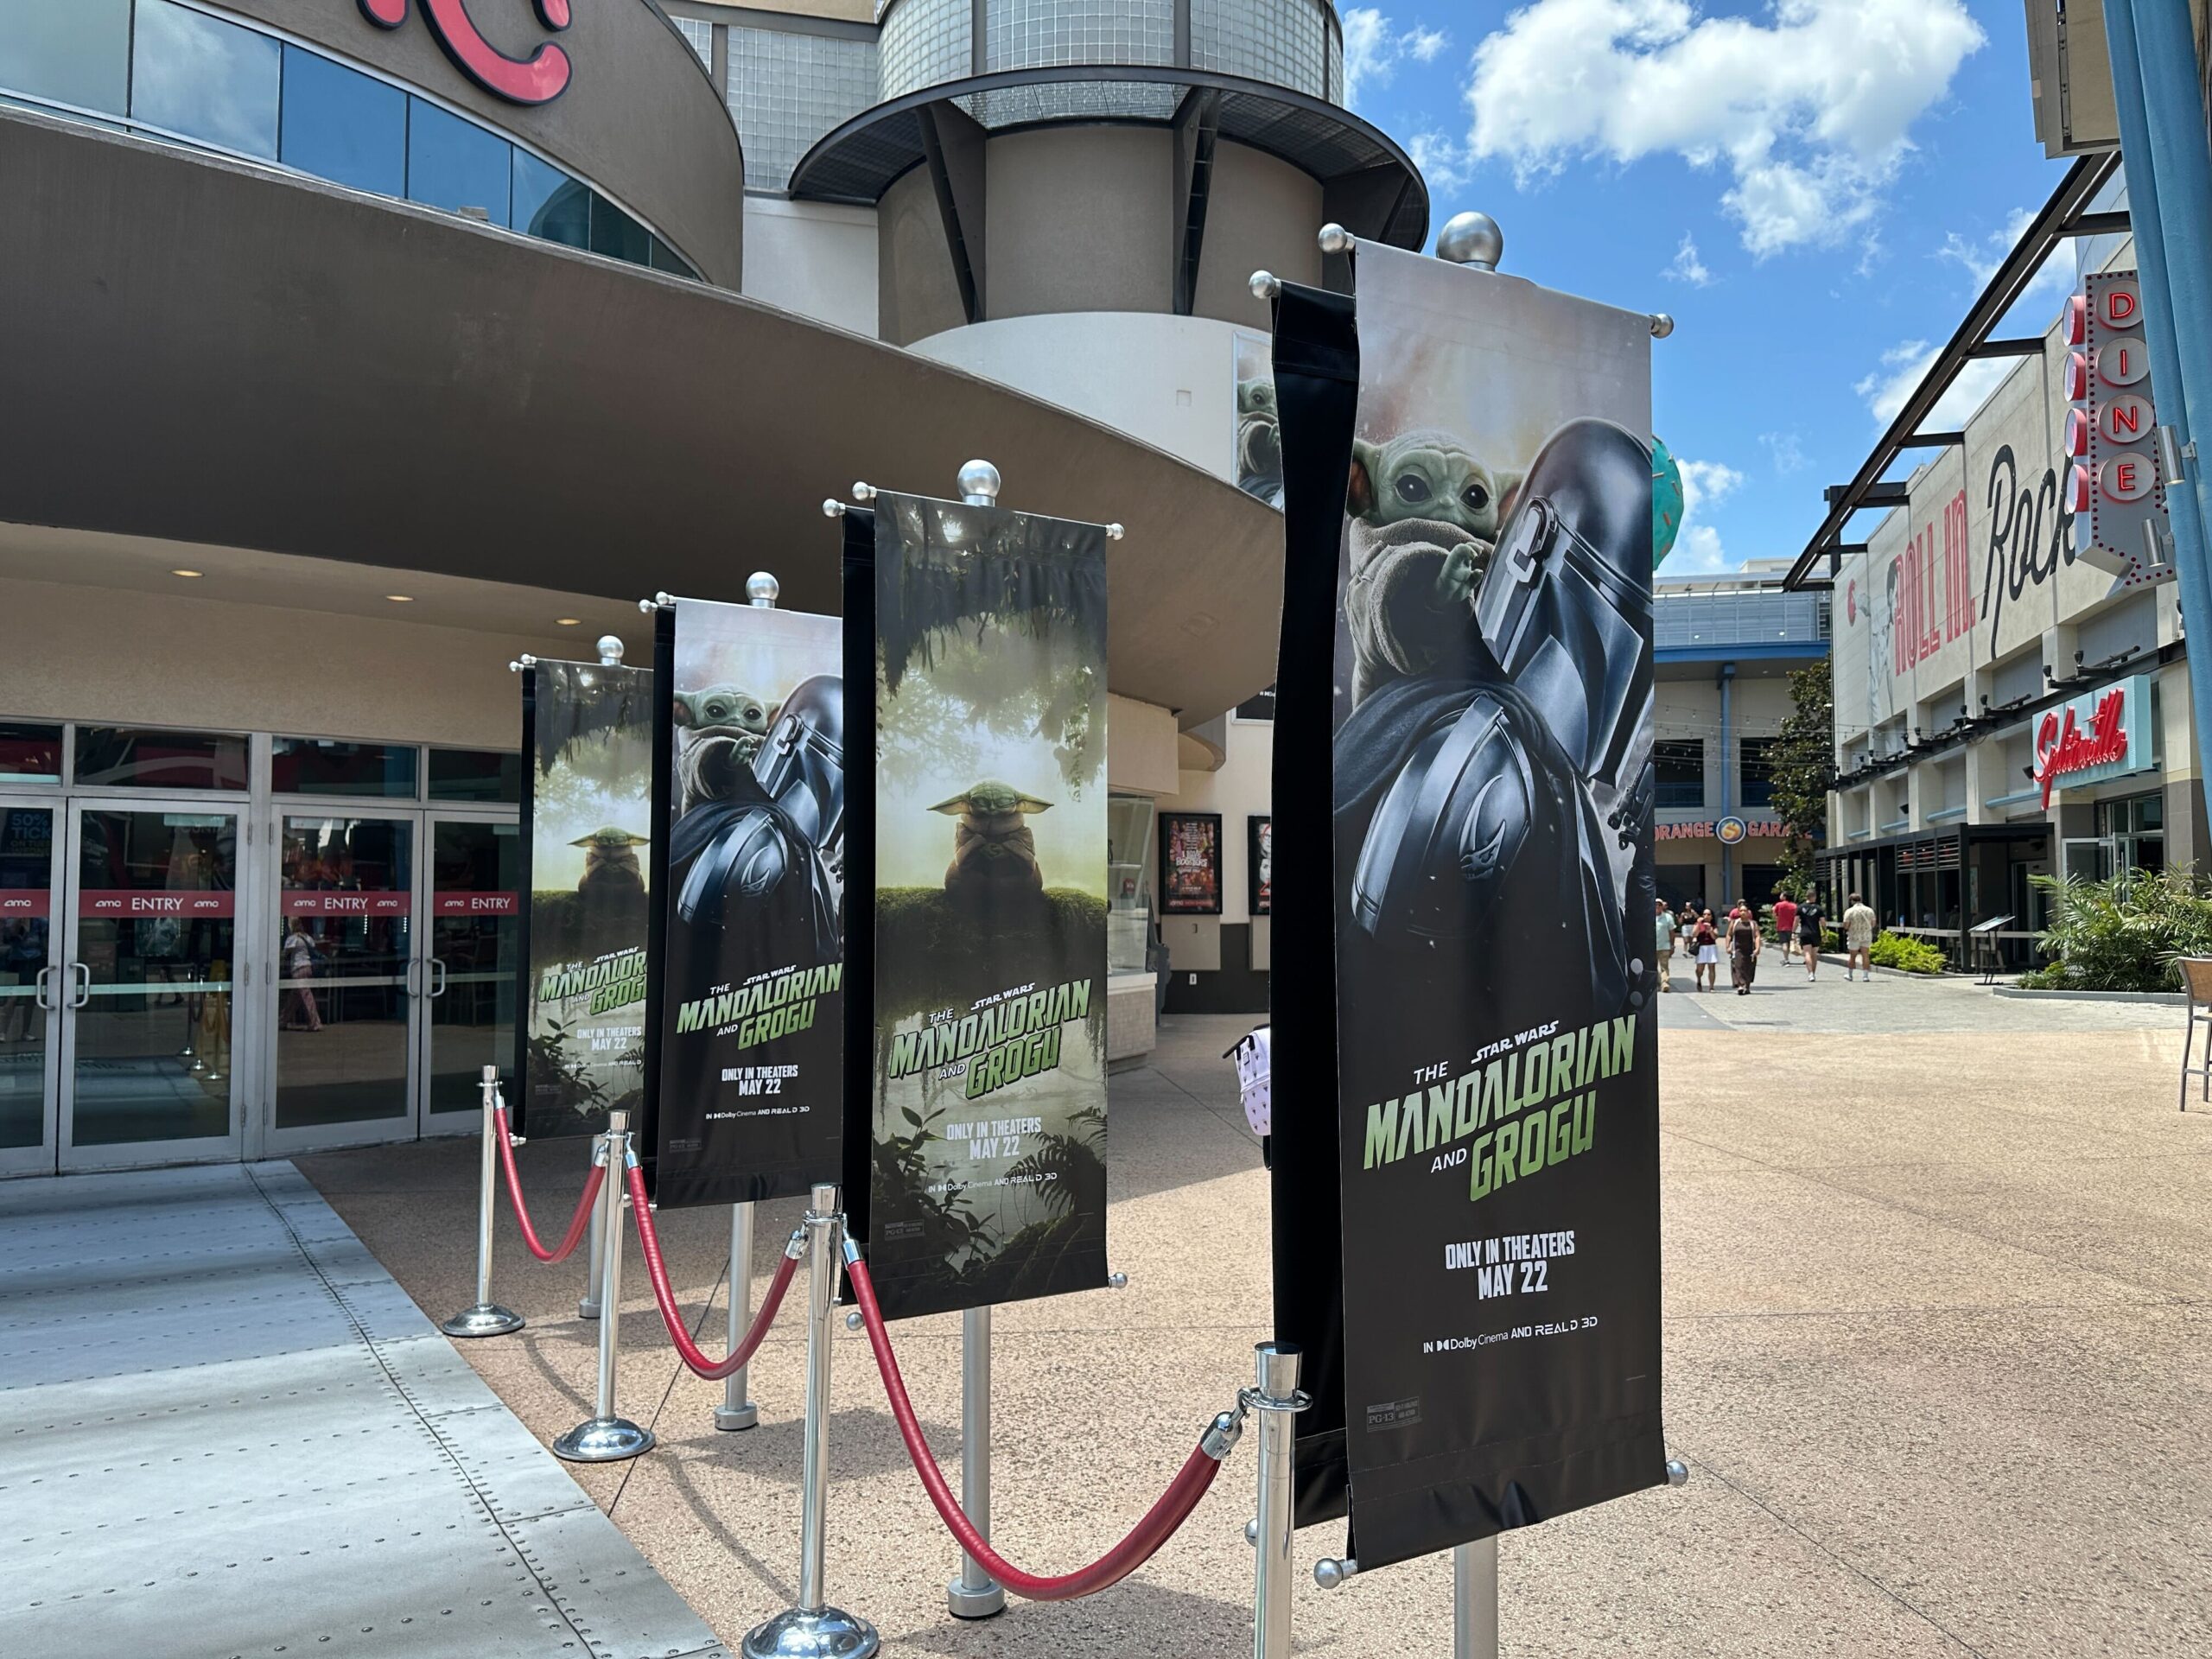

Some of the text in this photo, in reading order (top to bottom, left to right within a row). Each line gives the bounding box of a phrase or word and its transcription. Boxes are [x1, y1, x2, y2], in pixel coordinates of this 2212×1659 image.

[2108, 291, 2137, 492] DINE
[1894, 521, 1941, 677] ROLL
[131, 897, 184, 911] ENTRY
[324, 897, 369, 910] ENTRY
[471, 897, 511, 909] ENTRY
[566, 961, 583, 970] THE
[594, 946, 639, 963] STAR WARS
[742, 964, 798, 986] STAR WARS
[572, 976, 646, 1015] AND GROG
[676, 963, 843, 1034] MANDALORIAN
[709, 983, 731, 995] THE
[970, 982, 1035, 1010] STAR WARS
[716, 998, 817, 1051] AND GROGU
[929, 1007, 954, 1025] THE
[577, 1027, 642, 1039] ONLY IN THEATERS
[889, 978, 1091, 1080] MANDALORIAN
[591, 1037, 627, 1051] MAY 22
[1471, 1020, 1560, 1065] STAR WARS
[721, 1065, 798, 1082] ONLY IN THEATERS
[938, 1026, 1062, 1100] AND GROGU
[1413, 1060, 1449, 1085] THE
[739, 1077, 781, 1096] MAY 22
[1363, 1014, 1637, 1171] MANDALORIAN
[946, 1117, 1042, 1141] ONLY IN THEATERS
[969, 1135, 1020, 1160] MAY 22
[1430, 1090, 1597, 1202] AND GROGU
[948, 1182, 968, 1192] Dolby
[994, 1177, 1009, 1186] AND
[1045, 1172, 1058, 1180] 3D
[1445, 1230, 1575, 1270] ONLY IN THEATERS
[1478, 1261, 1548, 1300] MAY 22
[1423, 1341, 1433, 1354] IN
[1450, 1337, 1478, 1350] Dolby
[1478, 1331, 1509, 1345] Cinema
[1510, 1325, 1532, 1339] AND
[1581, 1316, 1599, 1329] 3D
[1369, 1412, 1394, 1424] PG-13
